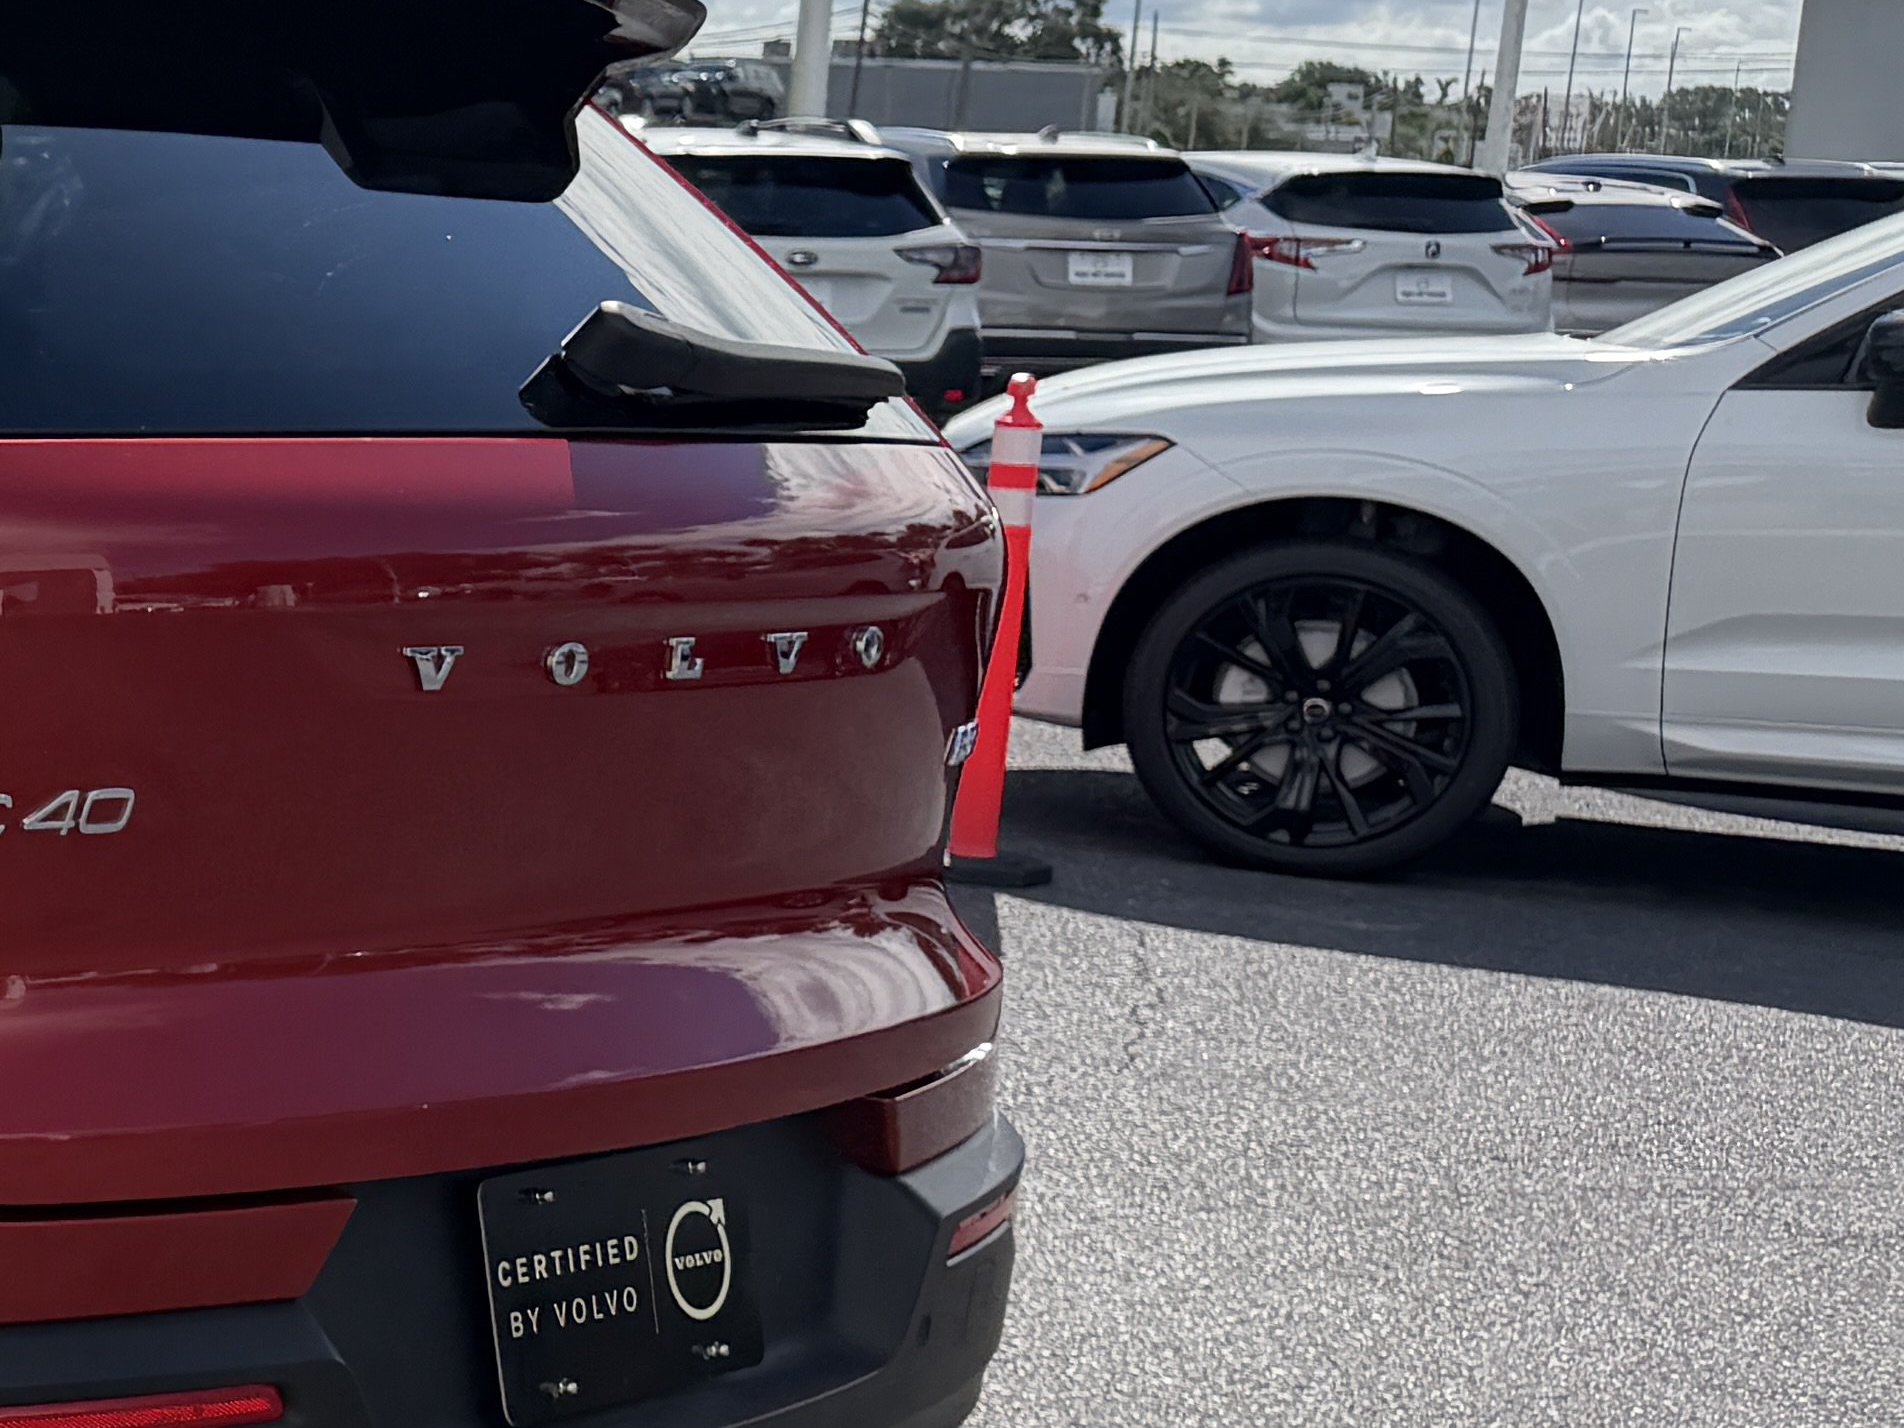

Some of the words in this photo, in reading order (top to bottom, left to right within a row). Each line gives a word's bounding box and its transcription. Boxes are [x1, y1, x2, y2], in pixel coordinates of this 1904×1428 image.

[400, 625, 885, 691] VOLVO
[497, 1235, 639, 1287] CERTIFIED
[674, 1248, 723, 1270] VOLVO
[509, 1306, 540, 1338] BY
[553, 1285, 638, 1328] VOLVO
